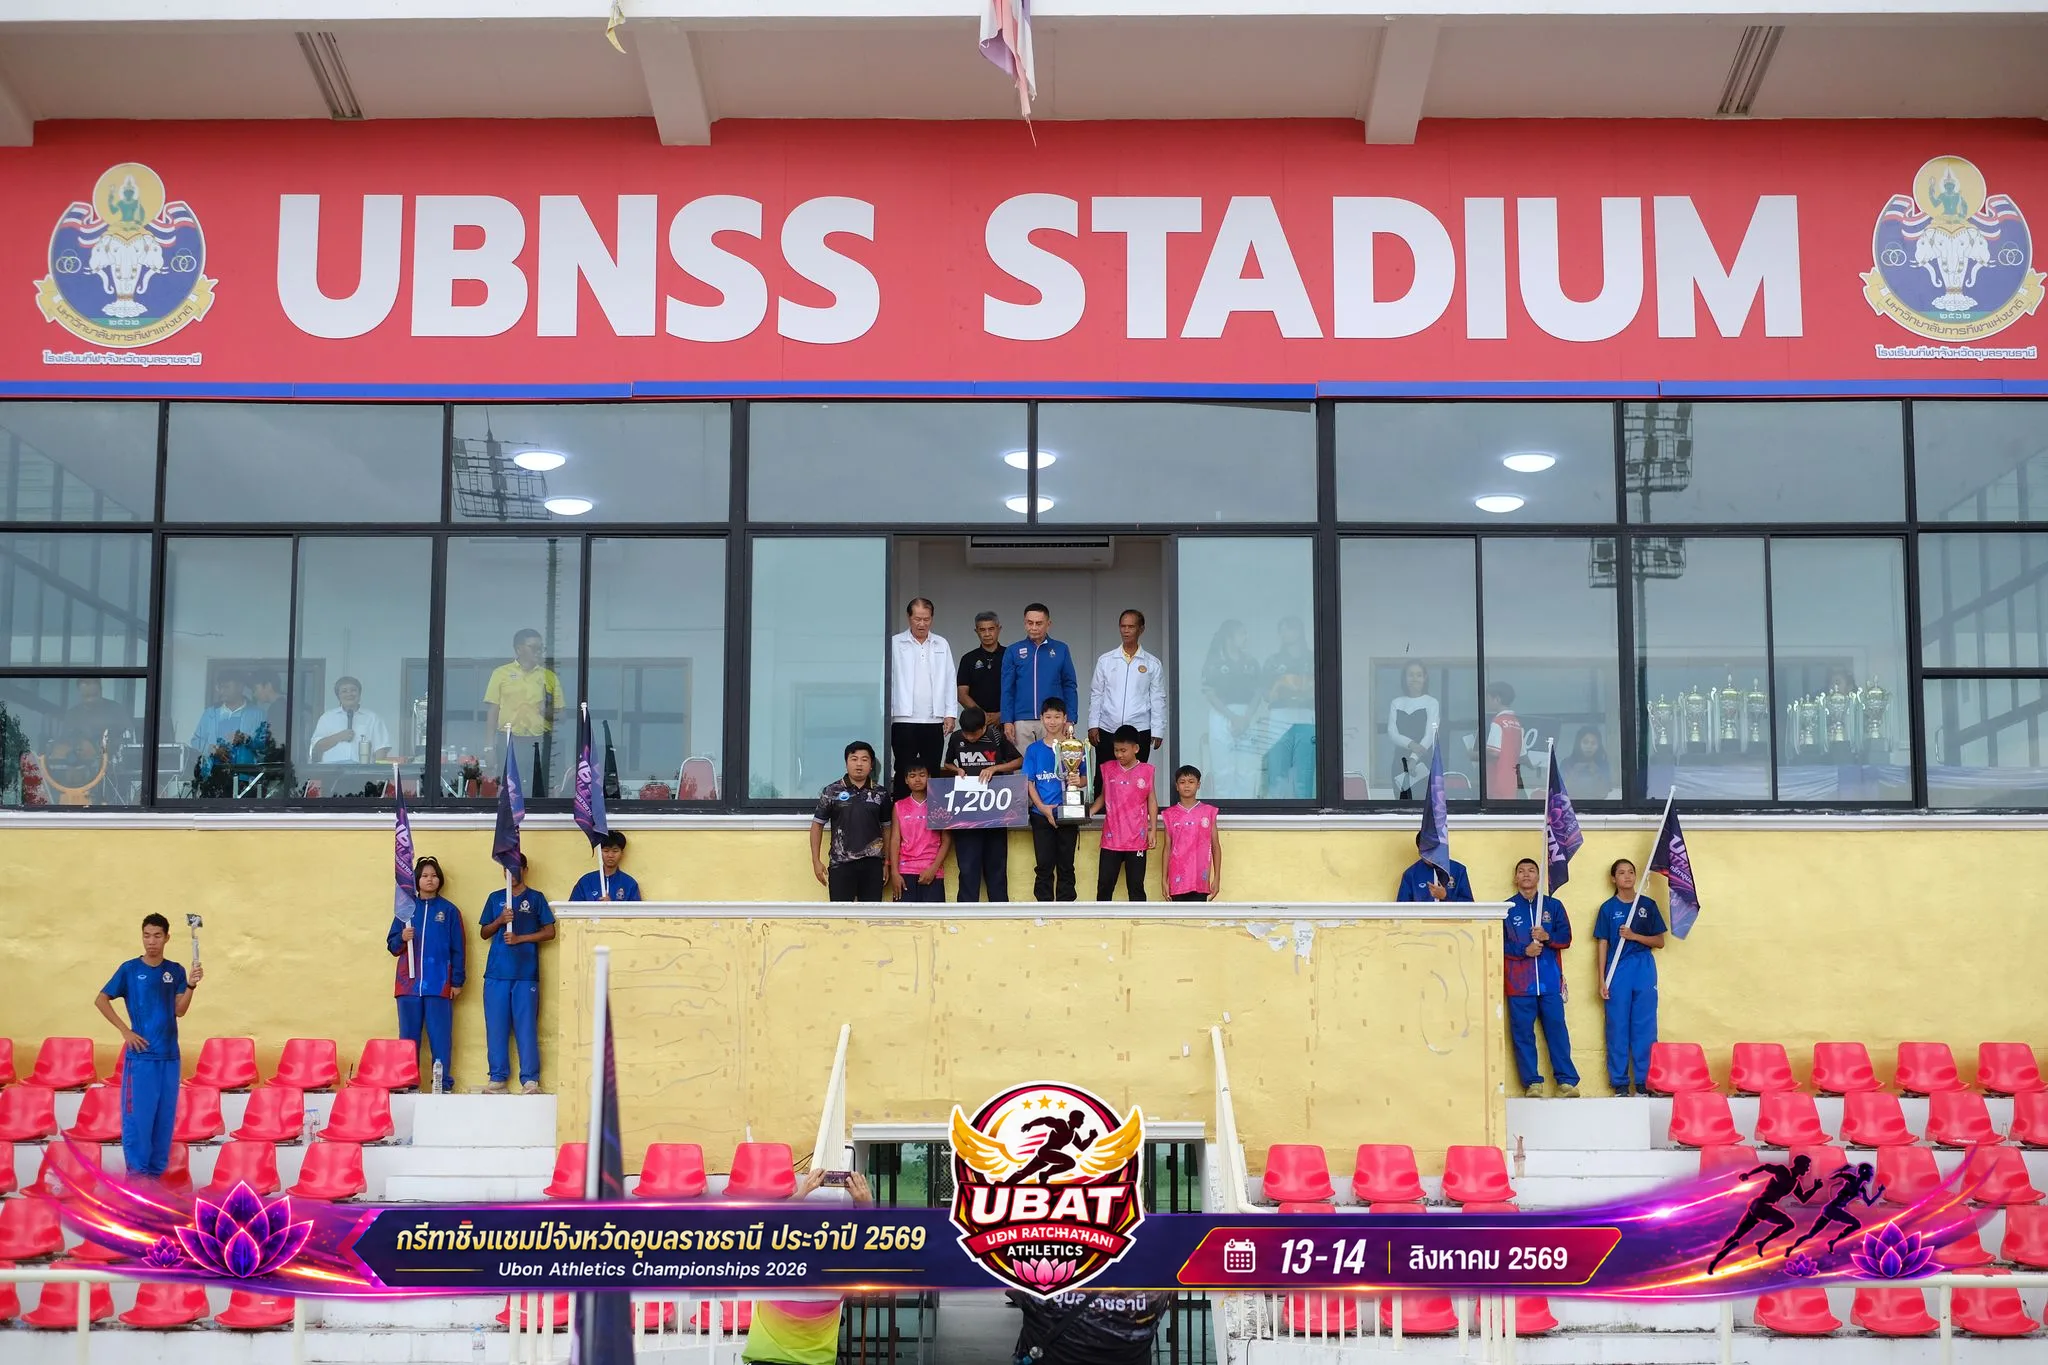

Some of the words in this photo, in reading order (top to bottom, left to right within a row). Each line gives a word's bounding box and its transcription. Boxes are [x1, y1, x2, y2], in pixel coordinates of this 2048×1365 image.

[278, 195, 879, 344] UBNSS
[984, 194, 1802, 341] STADIUM
[944, 787, 1012, 816] 1,200
